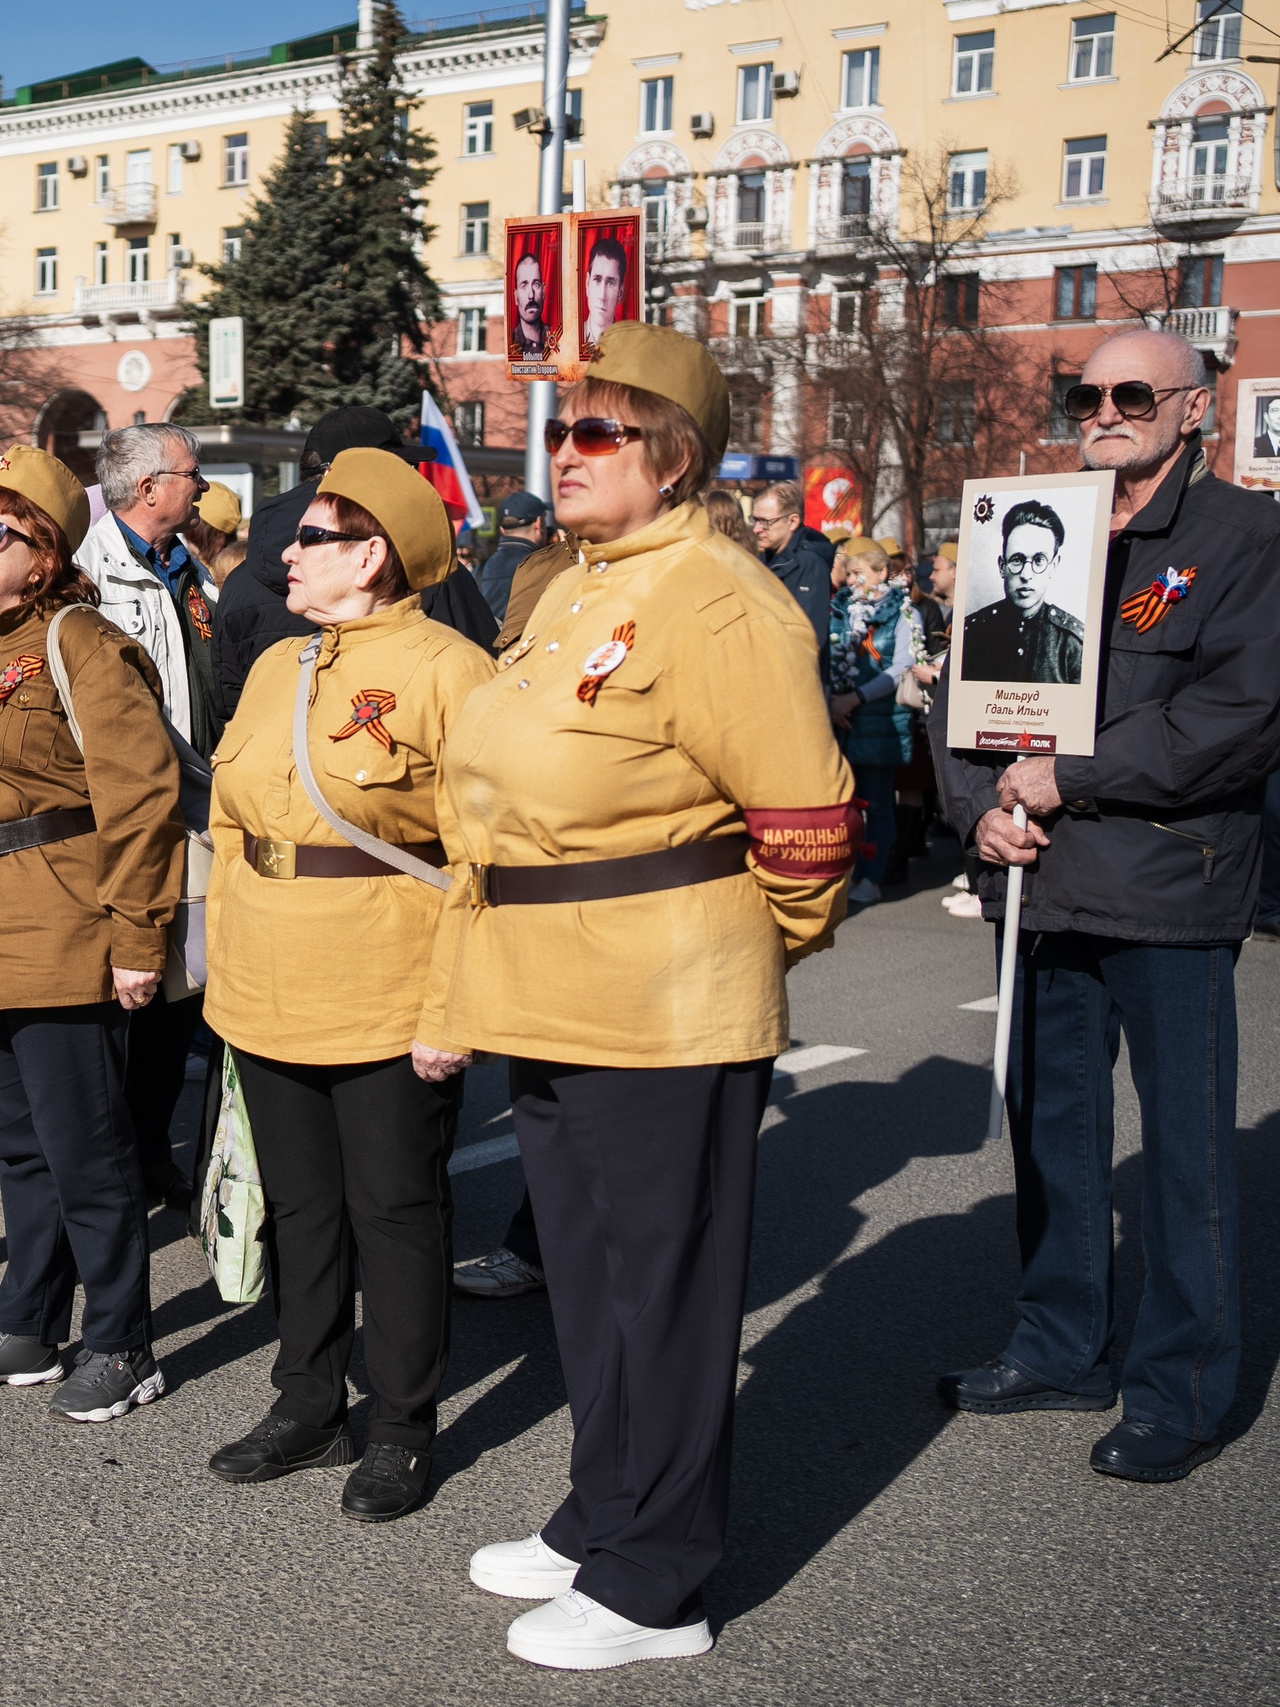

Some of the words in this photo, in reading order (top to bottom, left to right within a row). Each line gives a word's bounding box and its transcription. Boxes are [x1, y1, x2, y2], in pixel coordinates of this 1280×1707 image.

[511, 364, 536, 375] Константин
[537, 364, 558, 375] Егорович
[995, 689, 1040, 703] Мильруд
[985, 703, 1014, 715] Гдаль
[1016, 705, 1049, 716] Ильич
[763, 822, 848, 847] НАРОДНЫЙ
